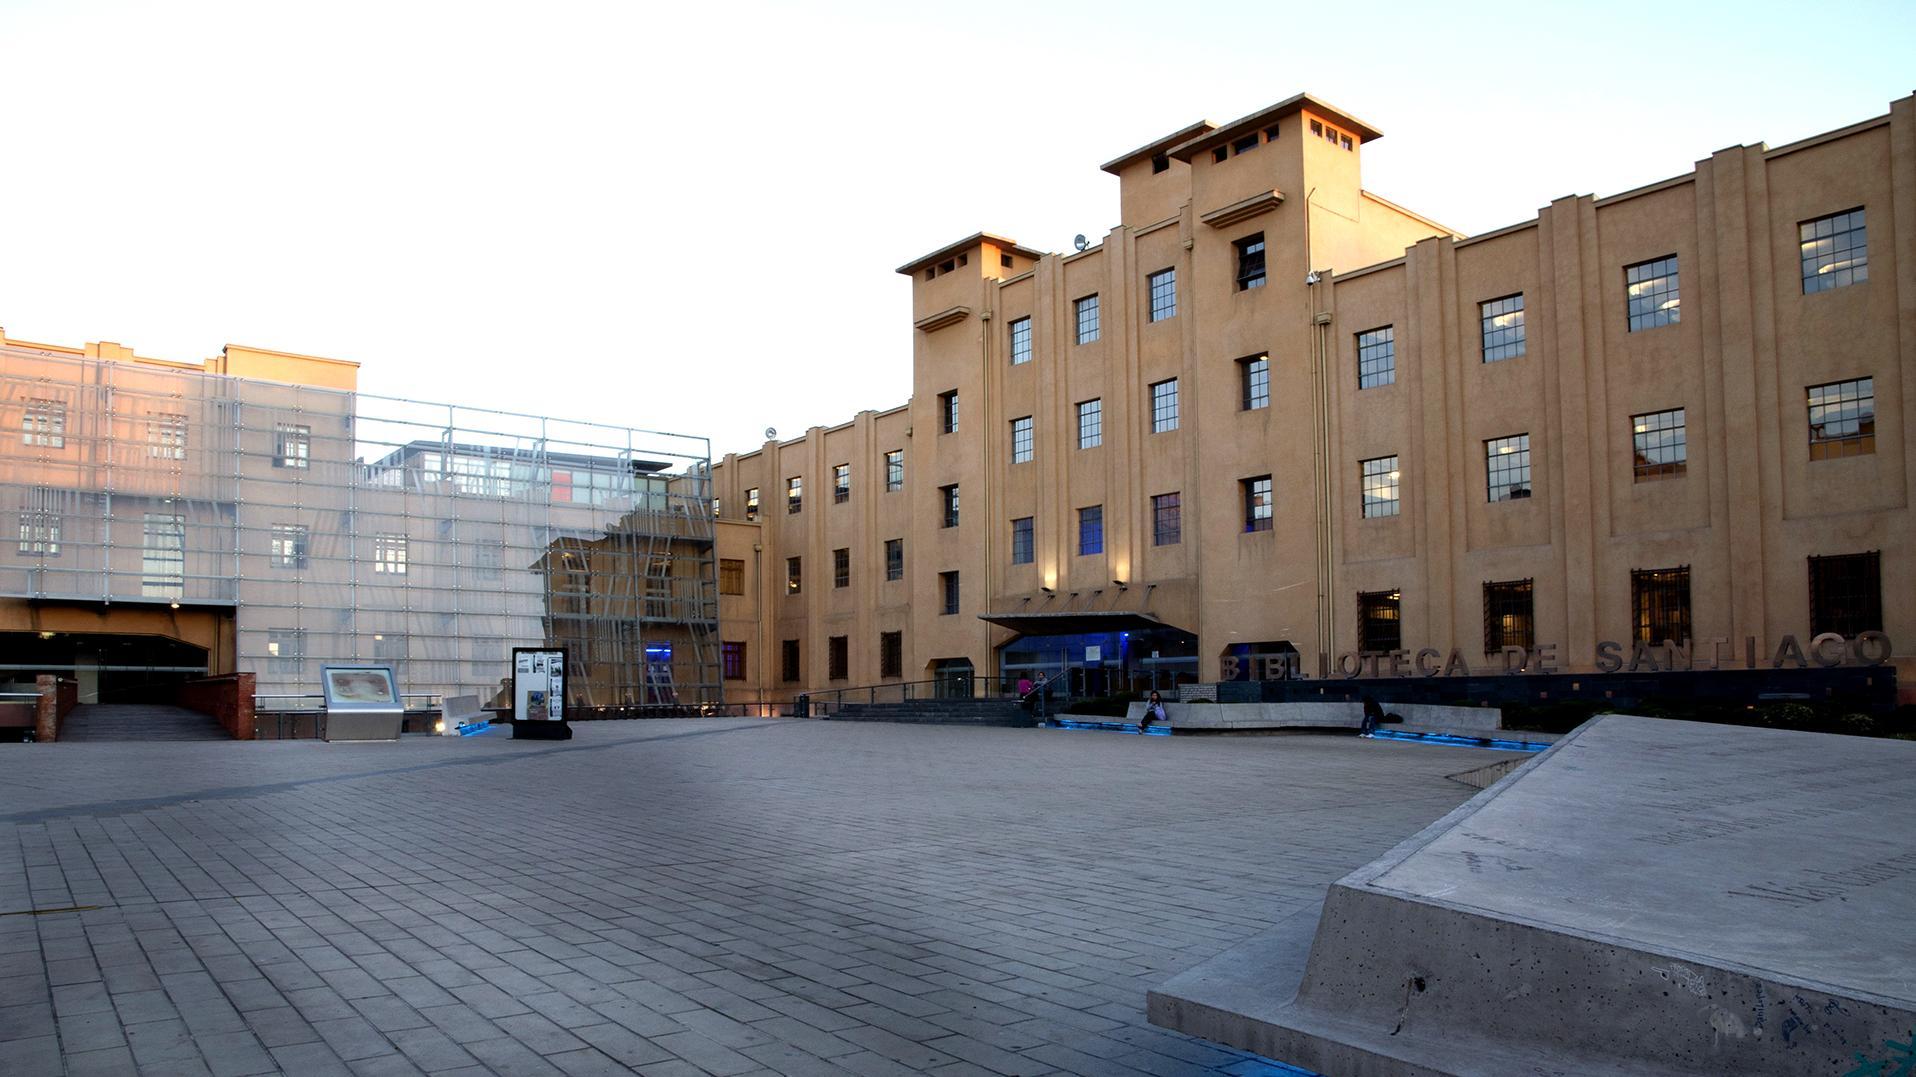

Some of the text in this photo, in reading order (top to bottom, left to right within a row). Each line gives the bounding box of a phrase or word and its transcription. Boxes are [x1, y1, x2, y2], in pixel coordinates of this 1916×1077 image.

[1219, 631, 1893, 681] BIBLIOTECA DE SANTIAGO
